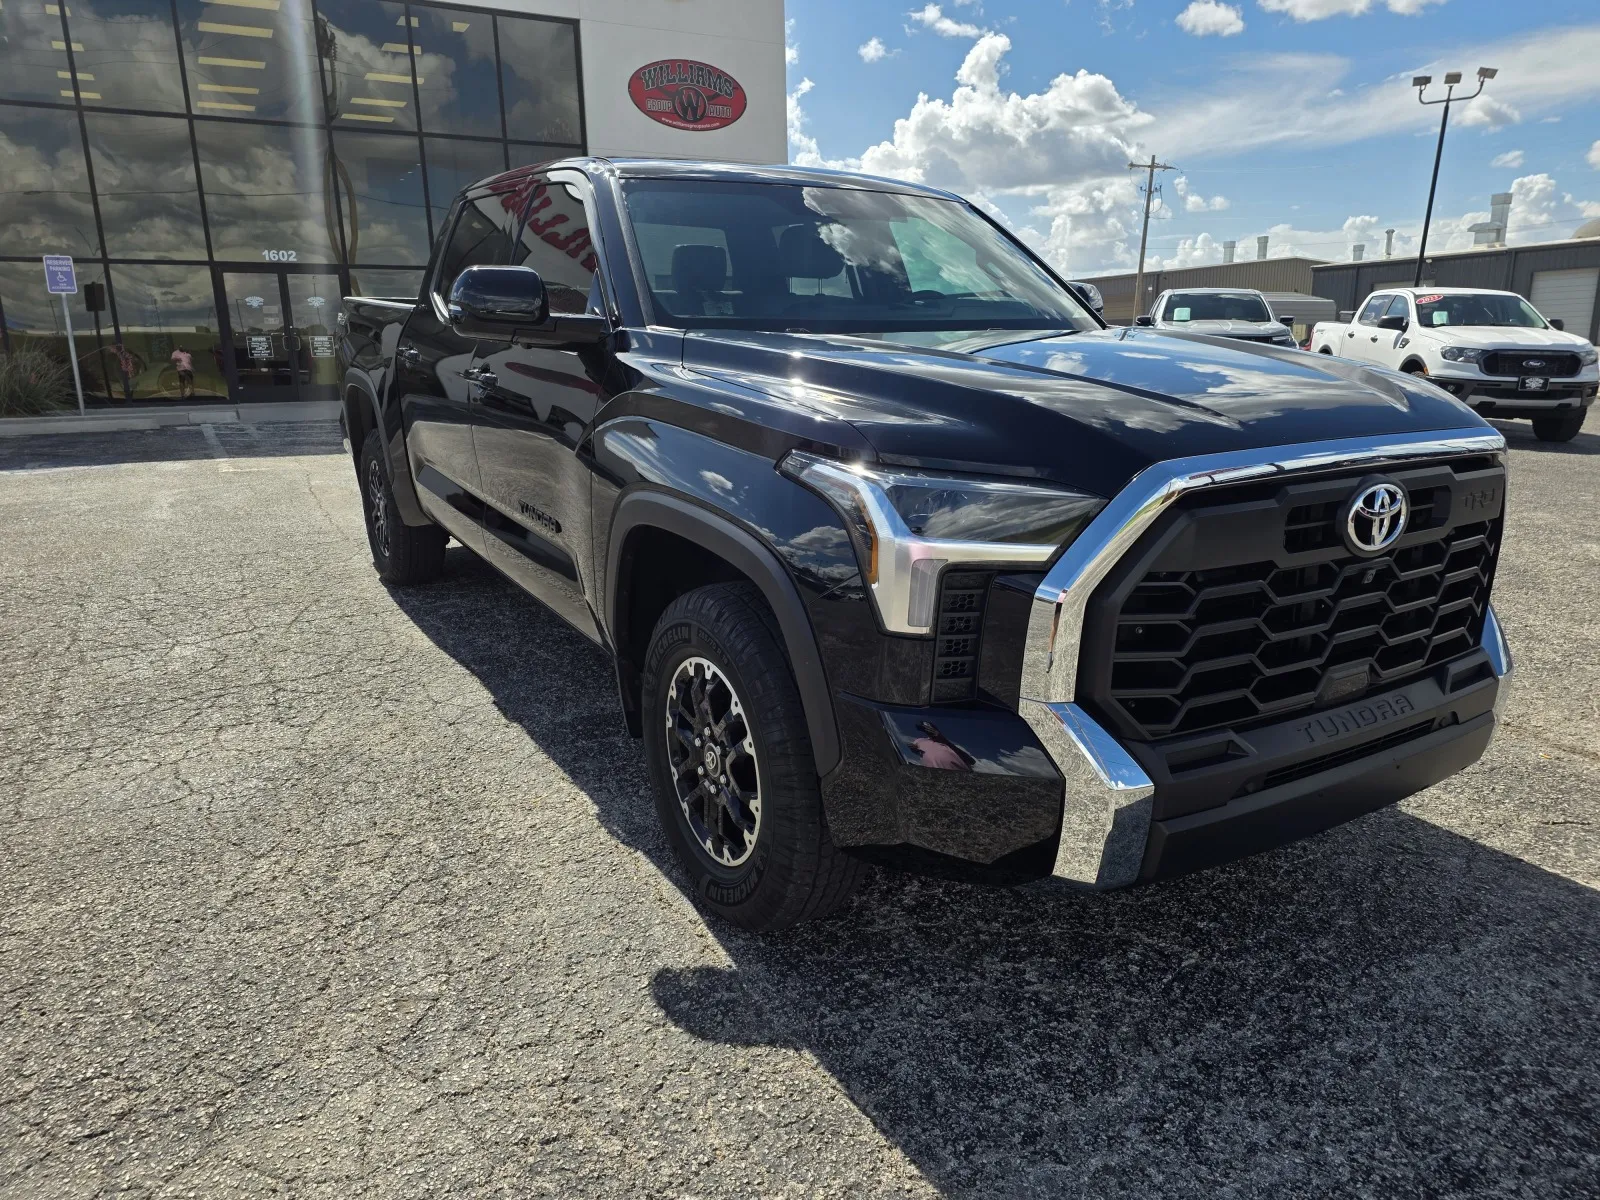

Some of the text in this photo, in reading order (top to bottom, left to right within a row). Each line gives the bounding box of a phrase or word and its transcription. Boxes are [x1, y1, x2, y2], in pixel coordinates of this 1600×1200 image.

[641, 63, 734, 98] WILLIAMS
[646, 99, 732, 118] GROUP AUTO
[262, 250, 297, 261] 1602
[650, 626, 689, 673] MICHELIN
[1296, 694, 1415, 743] TUNDRA
[710, 867, 759, 904] MICHELIN
